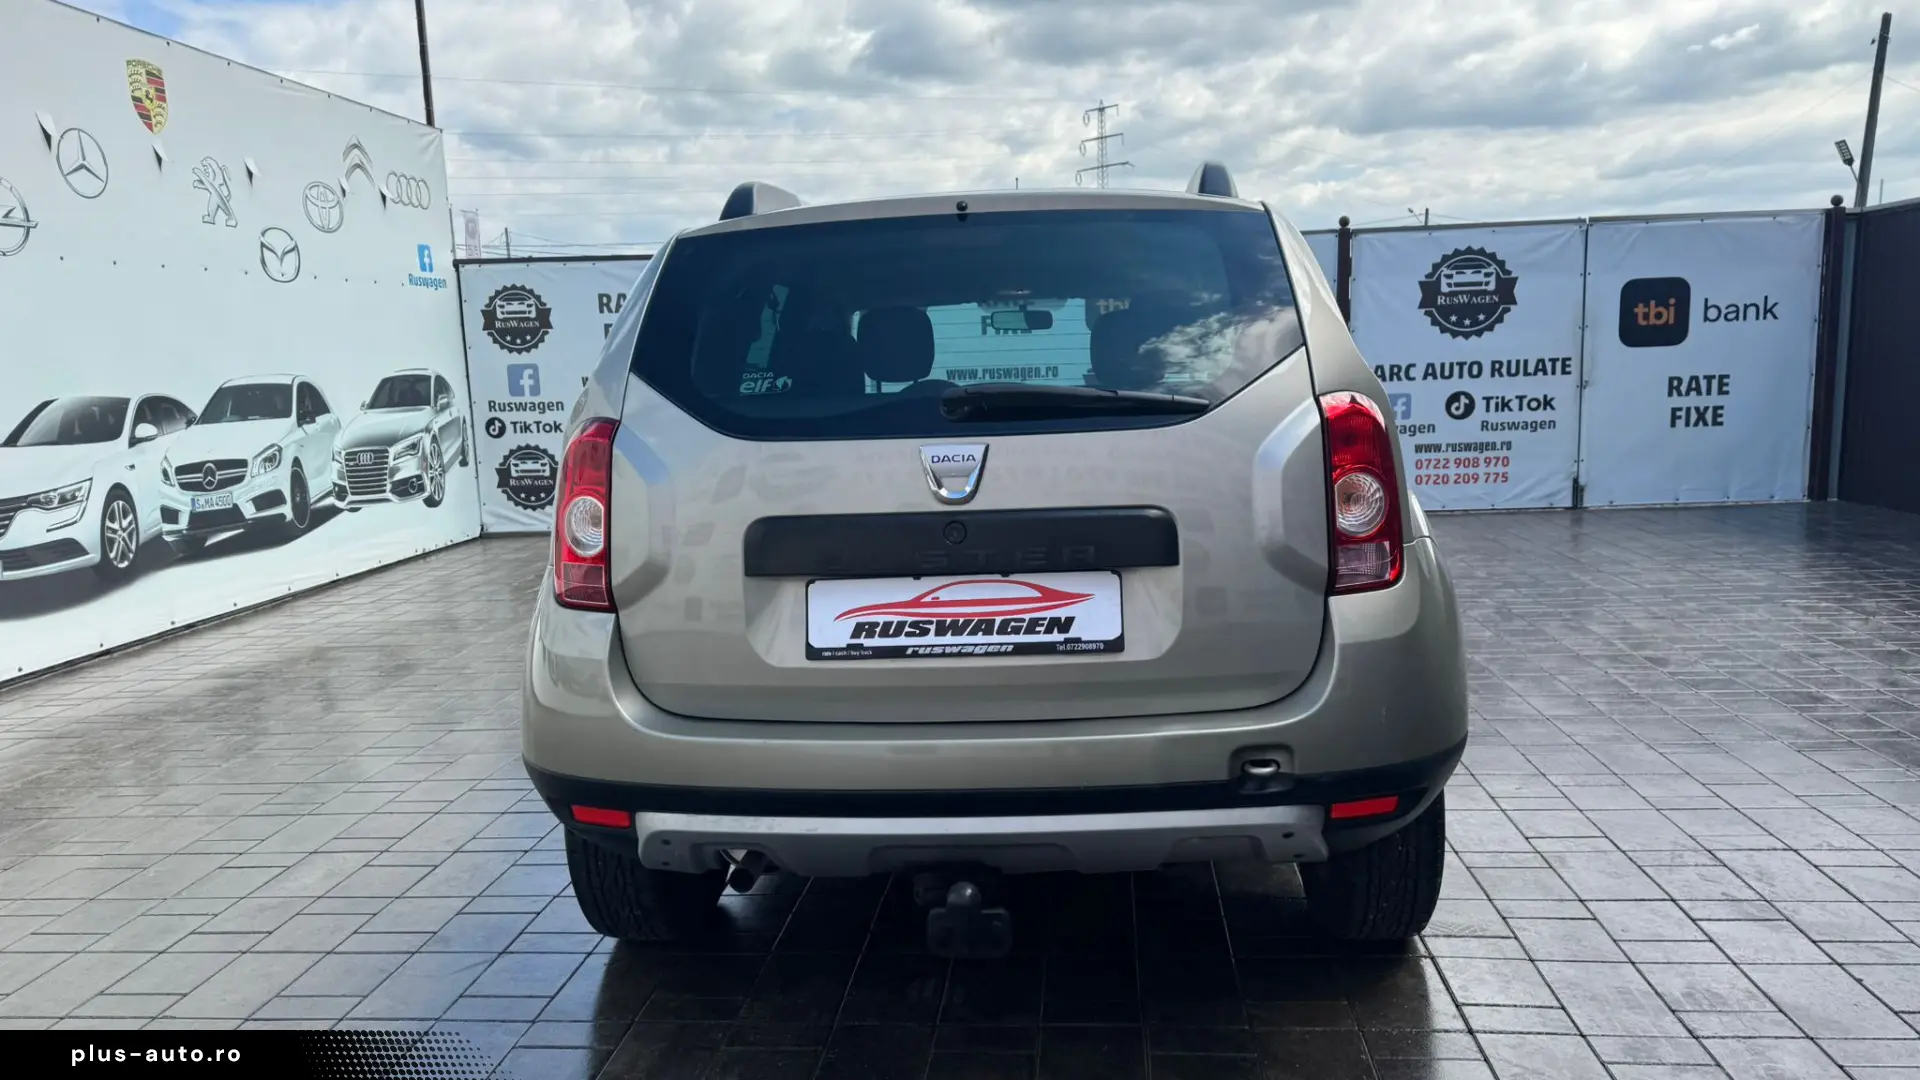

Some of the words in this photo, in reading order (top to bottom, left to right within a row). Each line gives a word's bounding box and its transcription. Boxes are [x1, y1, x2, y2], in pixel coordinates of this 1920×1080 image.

[408, 273, 447, 290] Ruswagen
[1634, 298, 1676, 326] tbi
[1703, 295, 1779, 323] bank
[946, 366, 1059, 381] www.ruswagen.ro
[1422, 360, 1483, 381] AUTO
[1490, 357, 1572, 379] RULATE
[1667, 374, 1730, 397] RATE
[488, 400, 564, 414] Ruswagen
[1482, 395, 1556, 413] TikTok
[1670, 405, 1724, 428] FIXE
[510, 421, 563, 434] TikTok
[1396, 423, 1436, 437] agen
[1481, 420, 1556, 432] Ruswagen
[1414, 440, 1512, 454] www.ruswagen.ro
[931, 454, 977, 464] DACIA
[1415, 458, 1450, 470] 0722
[1454, 457, 1480, 469] 908
[1484, 456, 1510, 468] 970
[1415, 474, 1449, 486] 0720
[1453, 473, 1479, 485] 209
[1484, 472, 1509, 484] 775
[850, 616, 1076, 640] RUSWAGEN
[906, 643, 1014, 655] ruswagen
